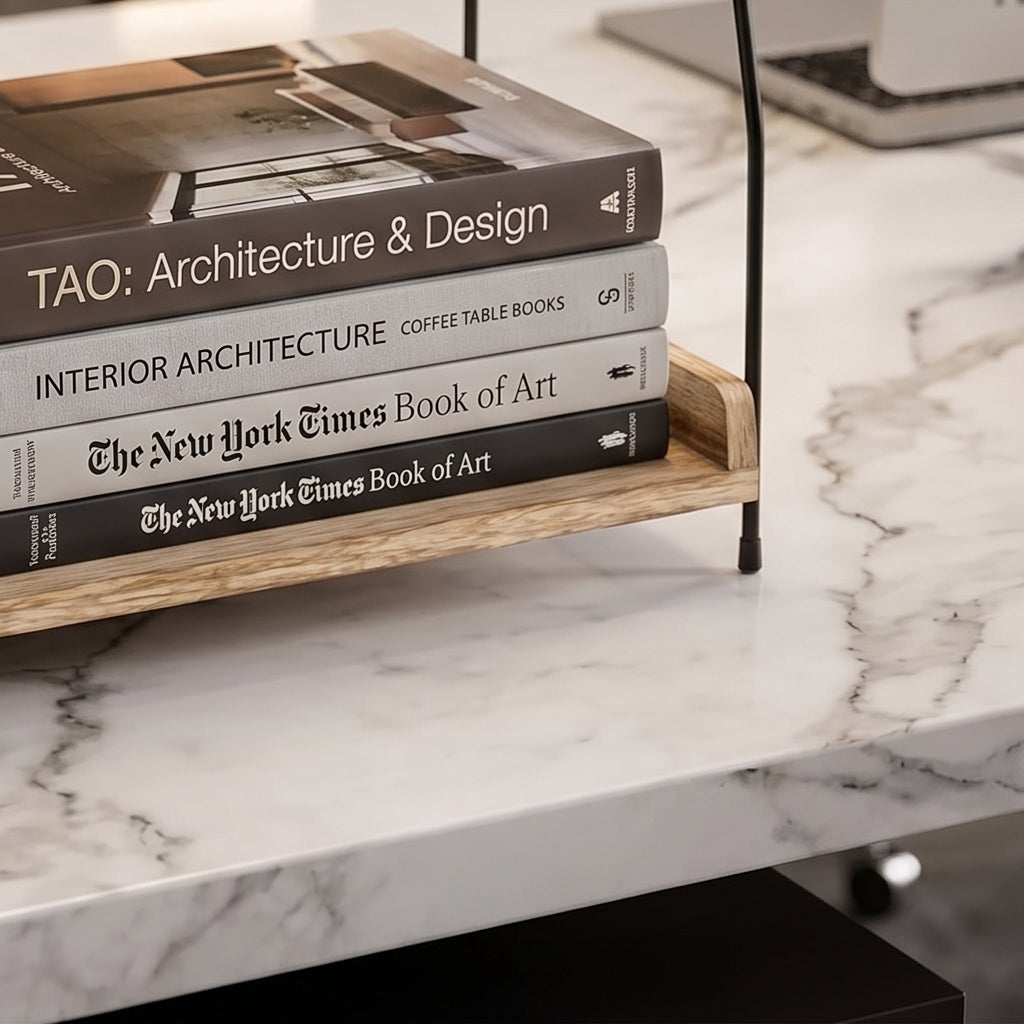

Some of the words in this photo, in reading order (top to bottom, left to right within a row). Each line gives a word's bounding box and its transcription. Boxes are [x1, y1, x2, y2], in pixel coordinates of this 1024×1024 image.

[27, 259, 132, 309] TAO:
[146, 230, 375, 293] Architecture
[386, 215, 413, 255] &
[426, 201, 548, 249] Design
[400, 312, 458, 336] COFFEE
[462, 304, 508, 326] TABLE
[512, 295, 565, 317] BOOKS
[36, 355, 168, 400] INTERIOR
[176, 320, 387, 377] ARCHITECTURE
[87, 438, 144, 477] The
[149, 428, 215, 470] New
[220, 409, 292, 462] York
[298, 403, 387, 439] Times
[394, 383, 470, 423] Book
[477, 374, 508, 410] of
[512, 372, 558, 404] Art
[140, 502, 183, 535] The
[186, 496, 236, 529] New
[239, 481, 294, 523] York
[297, 475, 365, 505] Times
[369, 460, 426, 492] Book
[431, 452, 455, 482] of
[456, 451, 492, 477] Art
